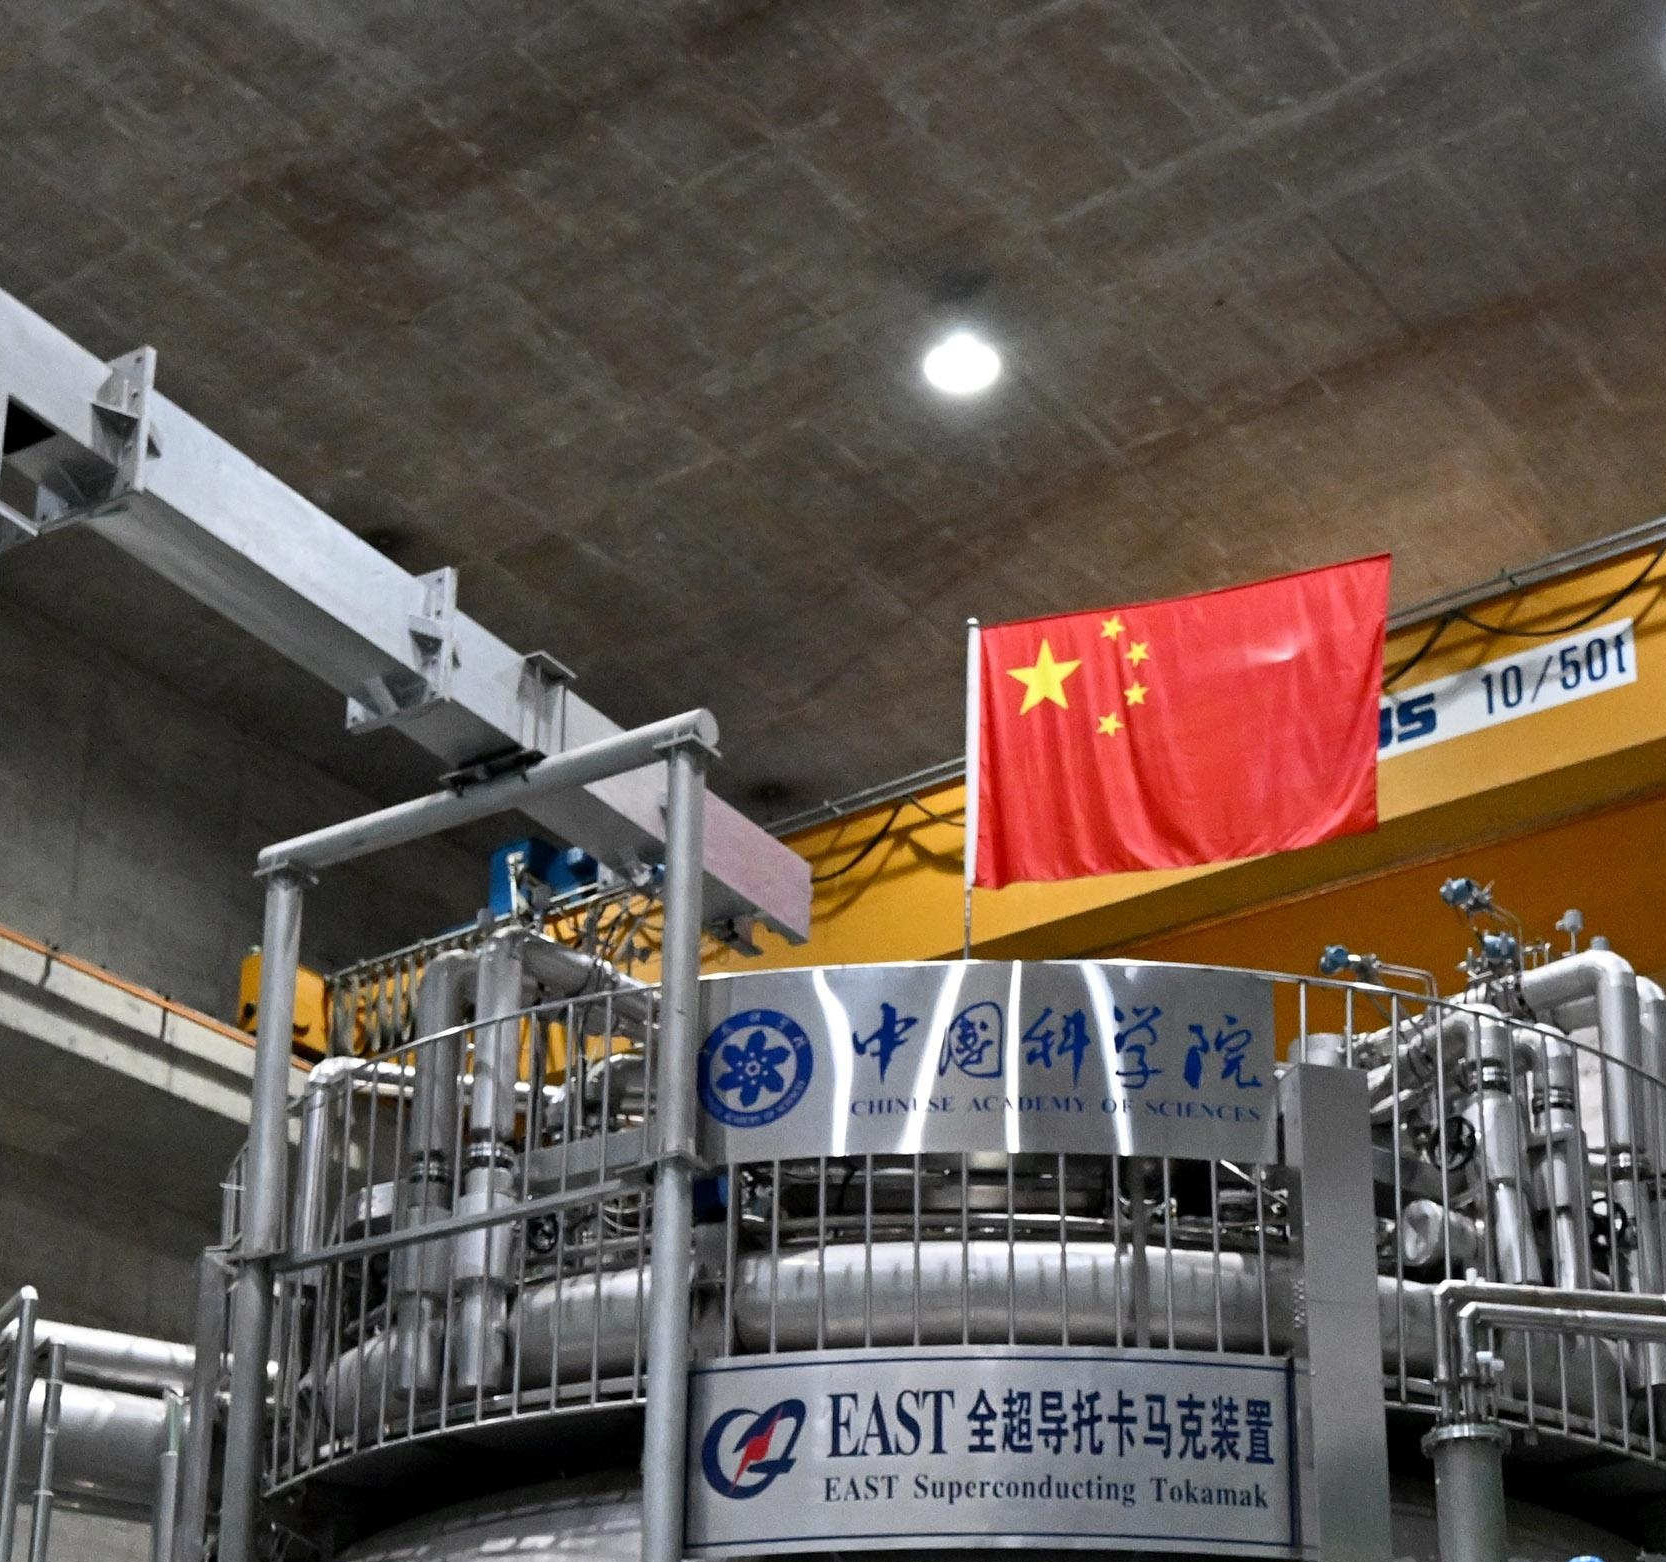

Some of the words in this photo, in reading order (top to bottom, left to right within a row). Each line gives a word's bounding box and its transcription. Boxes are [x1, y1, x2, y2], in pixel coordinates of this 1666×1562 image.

[1482, 634, 1628, 715] 10/50t
[1145, 1099, 1262, 1122] SCIENCES
[826, 1388, 955, 1458] EAST
[966, 1387, 1276, 1466] 全超导托卡马克装置
[823, 1474, 899, 1503] EAST
[912, 1473, 1137, 1508] Superconducting
[1149, 1476, 1270, 1510] Tokamak
